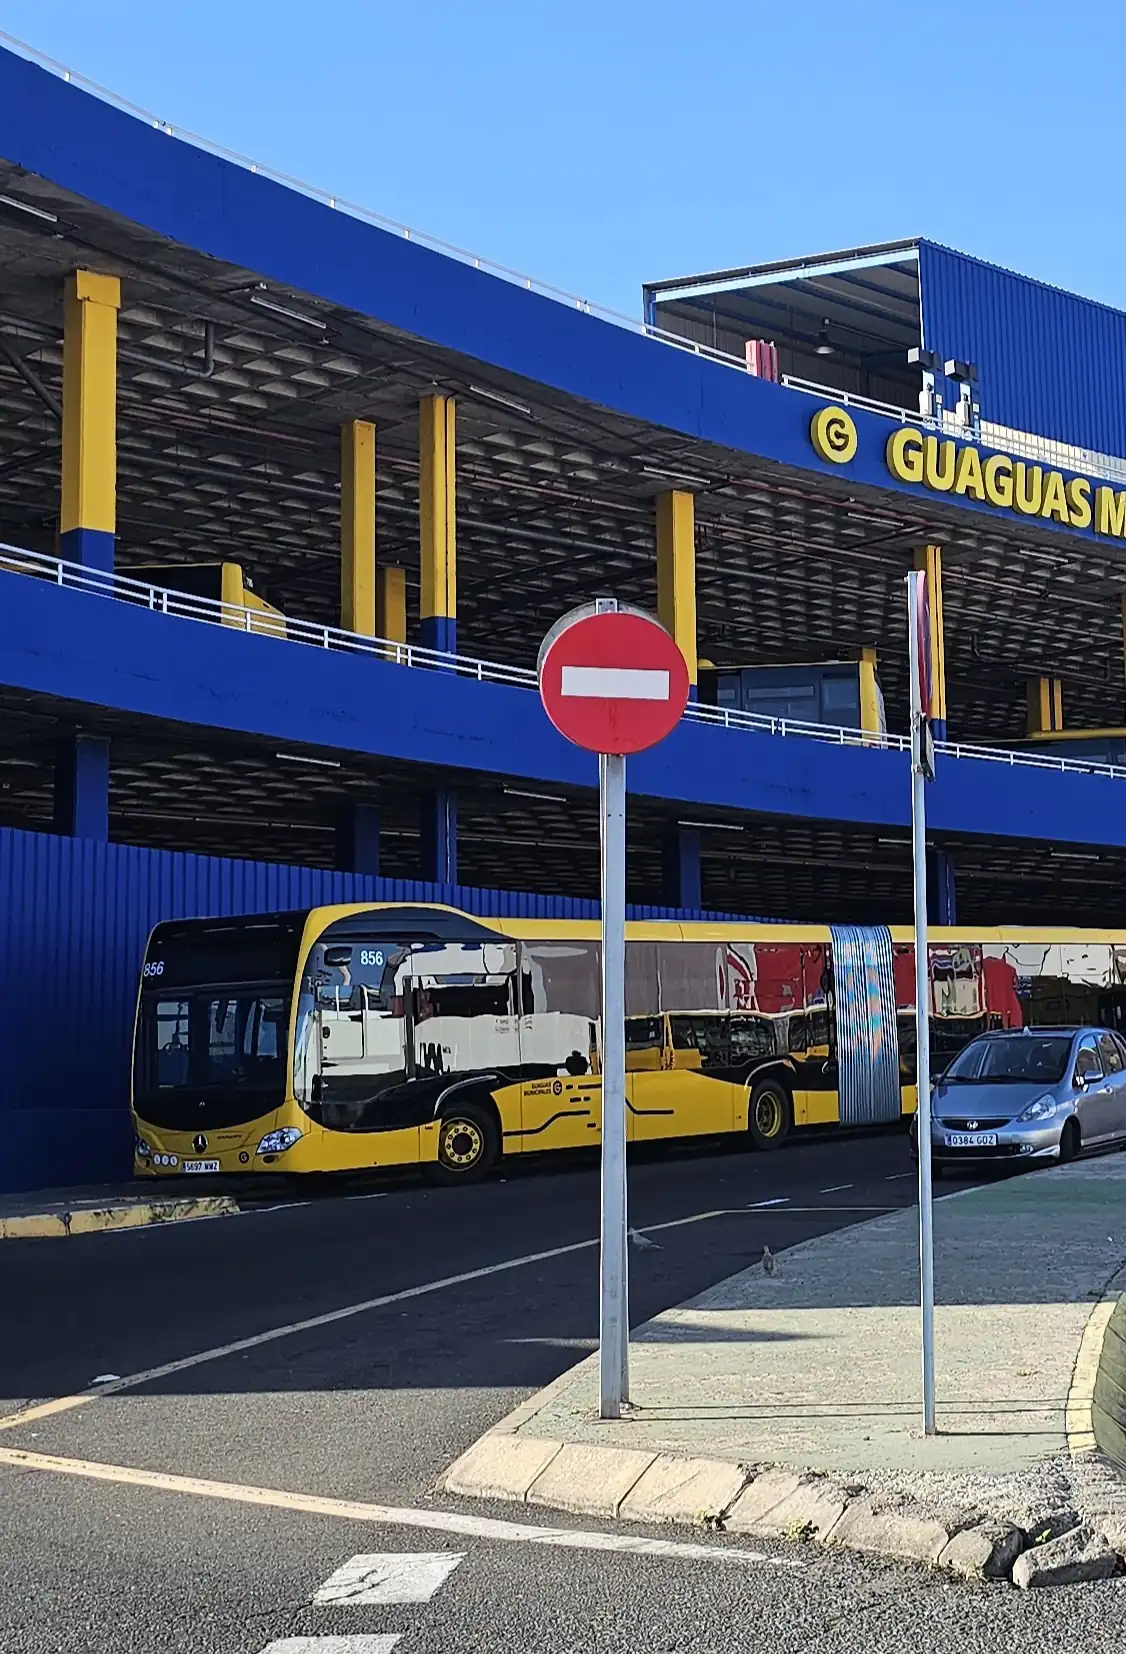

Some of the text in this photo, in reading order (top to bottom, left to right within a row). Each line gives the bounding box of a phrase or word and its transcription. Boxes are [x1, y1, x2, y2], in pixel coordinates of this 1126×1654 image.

[887, 427, 1092, 528] GUAGUAS
[361, 949, 384, 966] 856
[143, 960, 165, 978] 856
[952, 1135, 974, 1145] 0384
